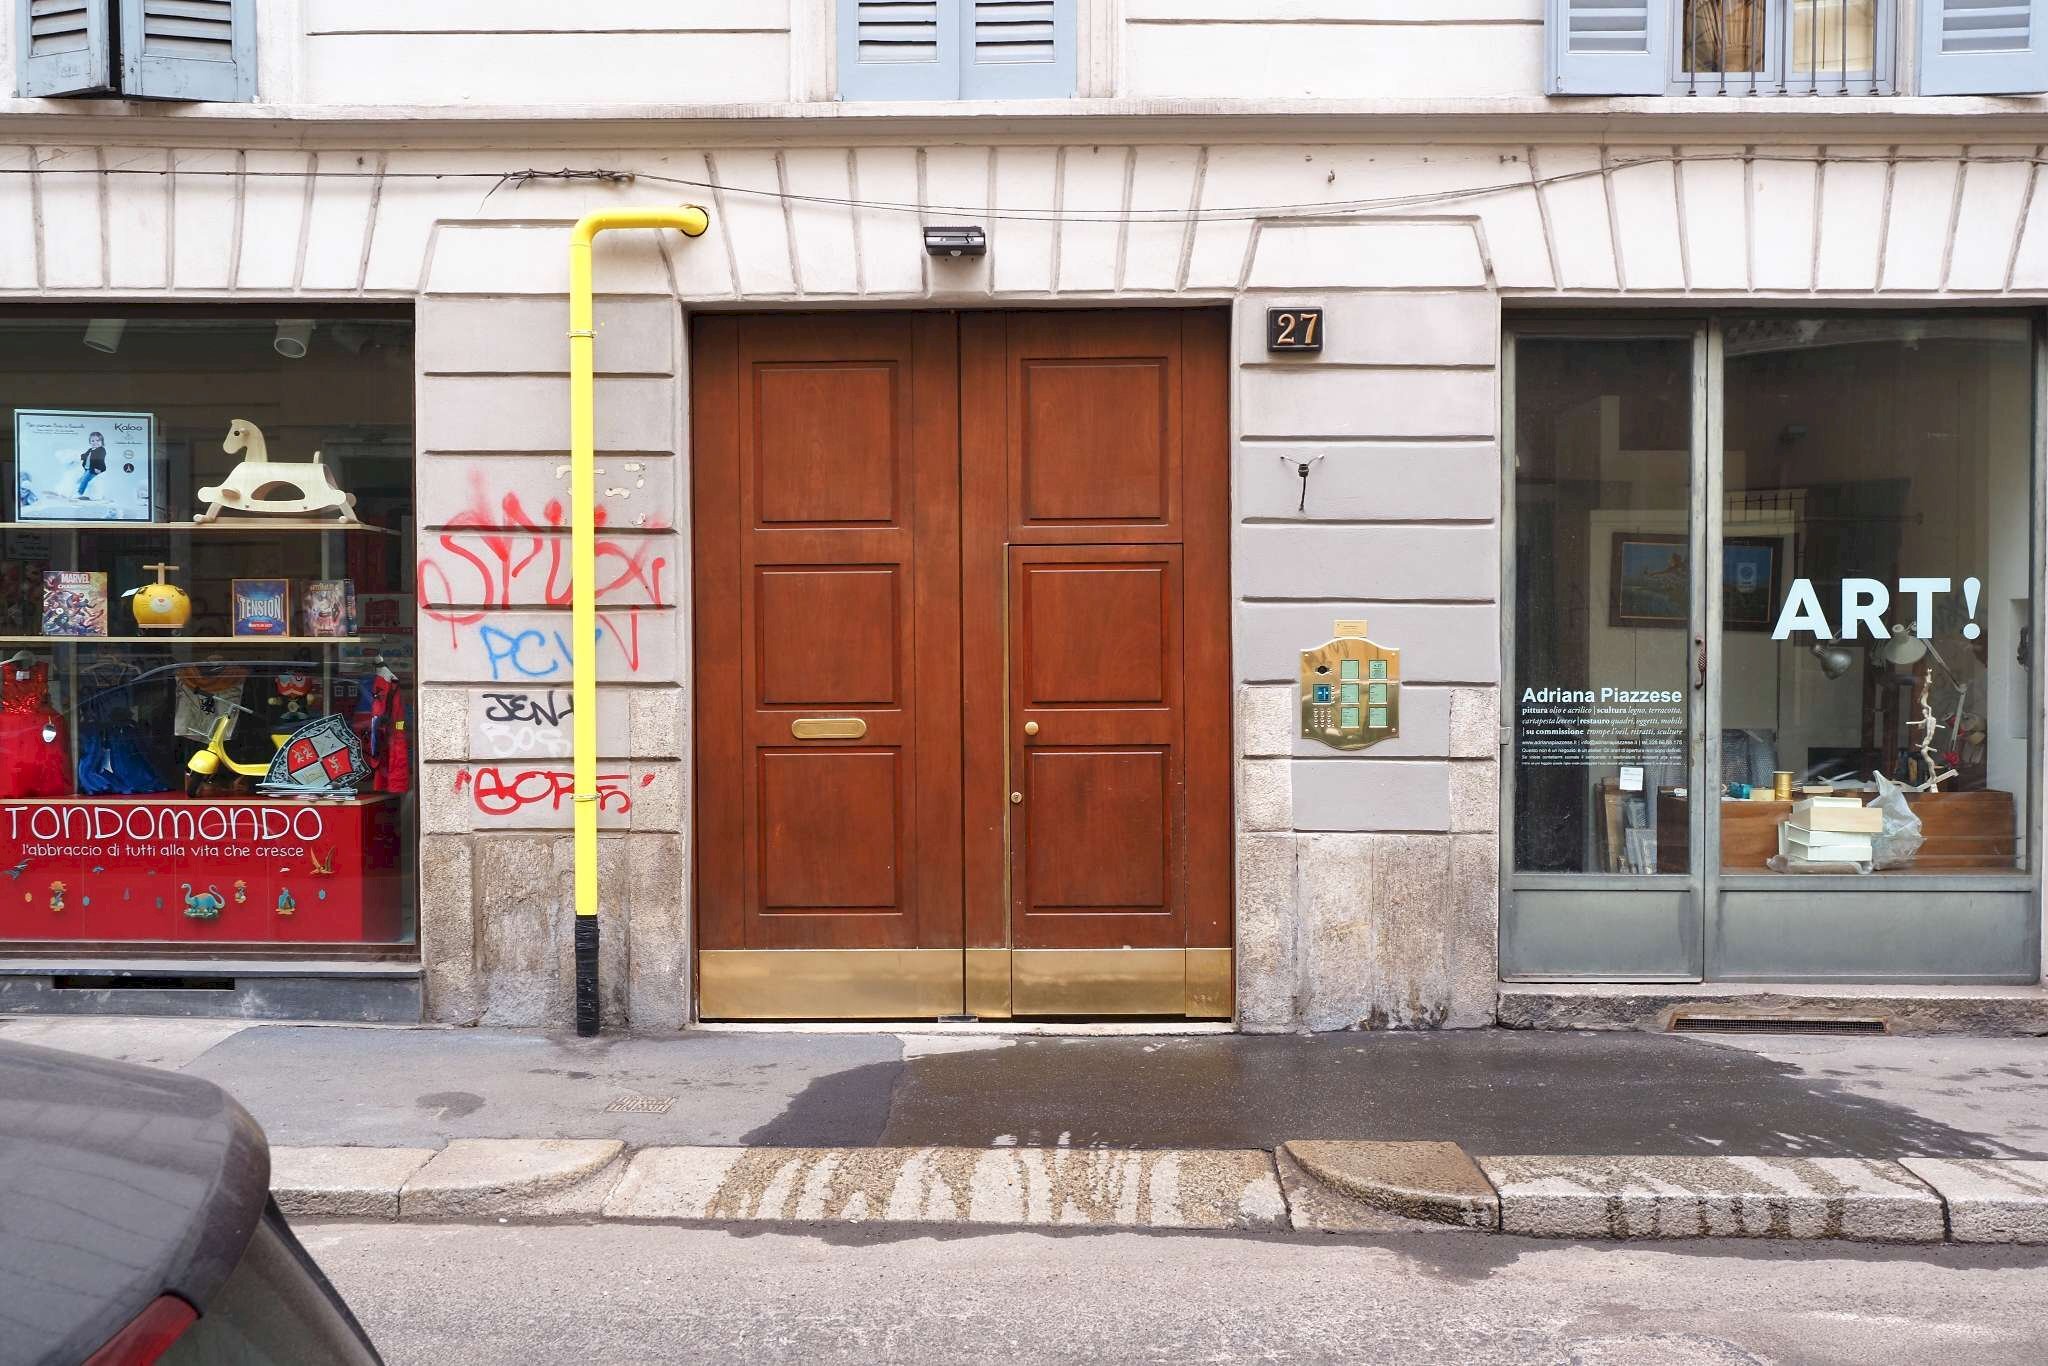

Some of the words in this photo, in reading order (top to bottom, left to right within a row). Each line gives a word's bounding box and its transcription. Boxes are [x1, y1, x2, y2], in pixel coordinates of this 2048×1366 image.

[1277, 313, 1318, 344] 27
[114, 423, 142, 432] Kaloo
[61, 573, 90, 584] MARVEL
[1771, 577, 1981, 640] ART!
[1522, 688, 1595, 702] Adriana
[1601, 688, 1682, 702] Piazzese
[1522, 706, 1548, 715] pittura
[1549, 706, 1561, 714] olio
[1567, 706, 1592, 714] acrilico
[1597, 706, 1626, 714] scultura
[22, 843, 102, 857] l'abbraccio
[107, 843, 120, 857] di
[126, 843, 156, 857] tutti
[160, 844, 185, 857] alla
[191, 844, 219, 857] vita
[224, 844, 250, 857] che
[256, 846, 304, 857] cresce
